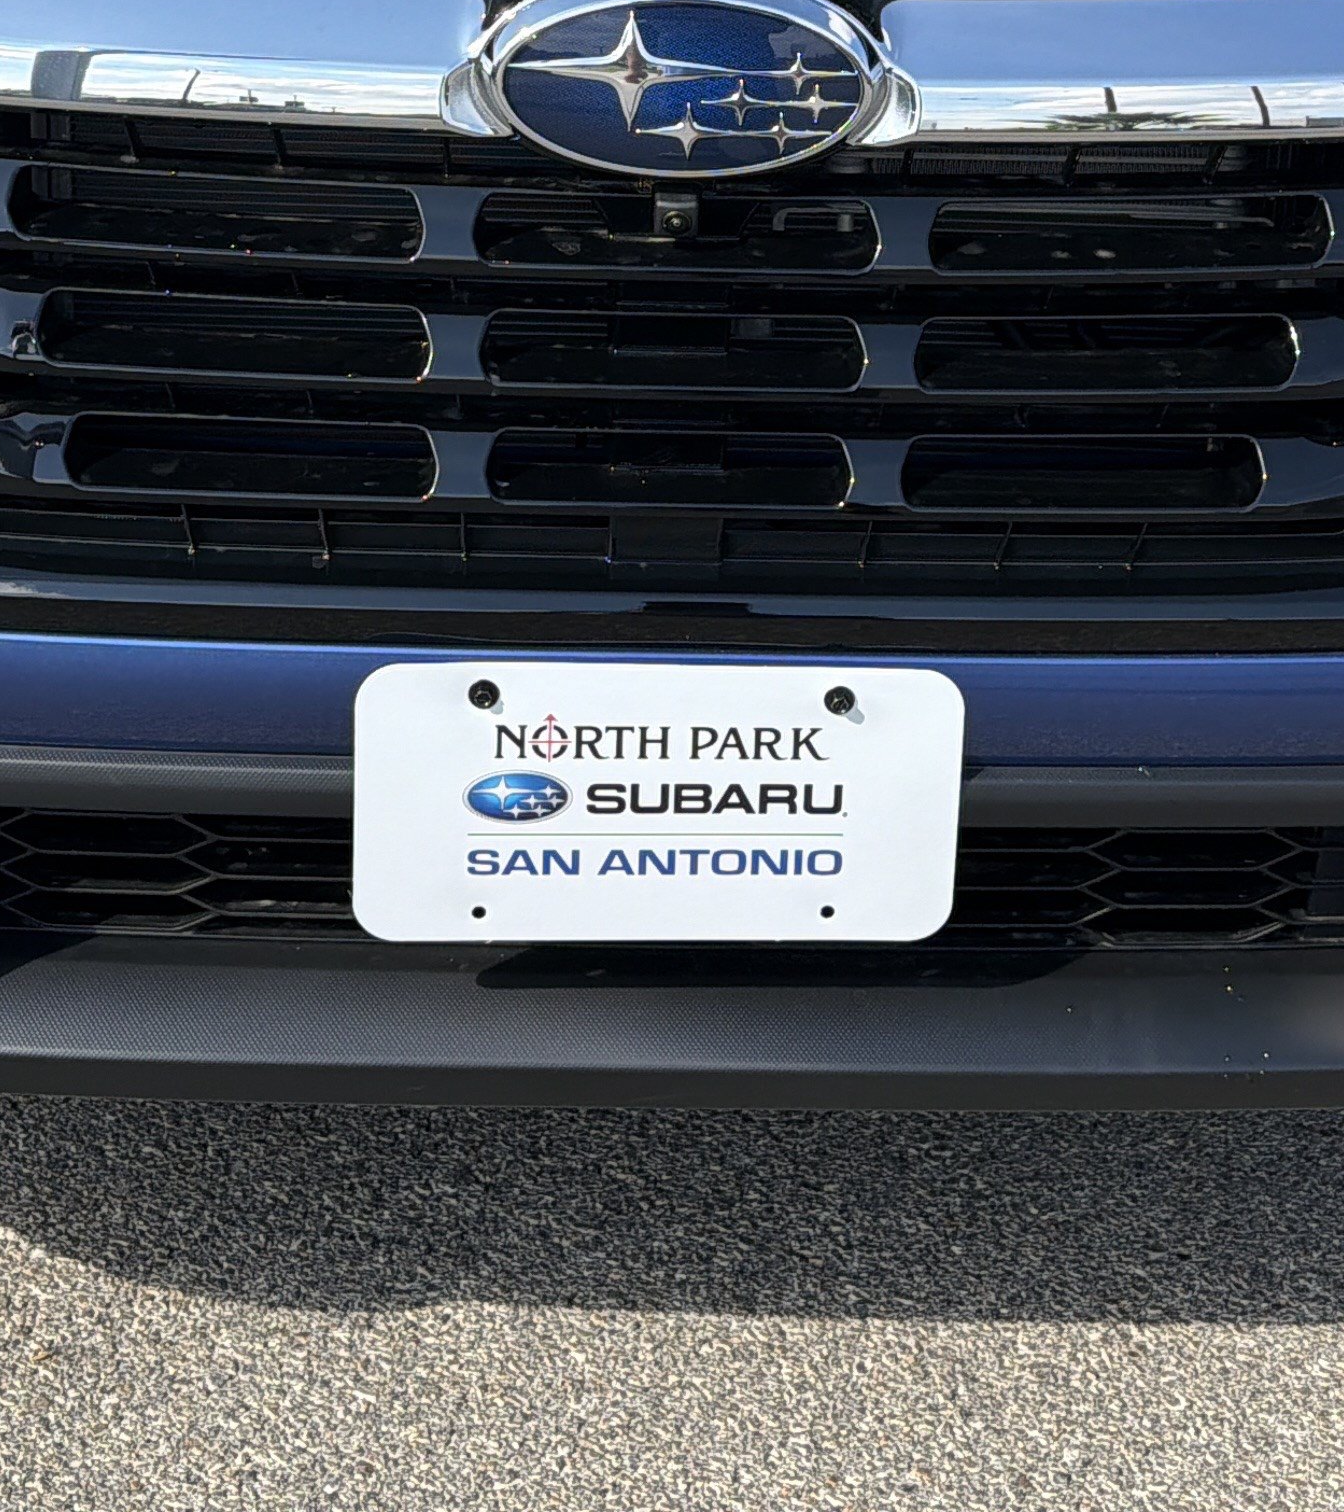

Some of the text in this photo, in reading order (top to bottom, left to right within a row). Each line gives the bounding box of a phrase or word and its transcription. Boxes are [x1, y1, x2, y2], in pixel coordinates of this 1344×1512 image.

[494, 722, 830, 761] NORTH PARK
[587, 784, 844, 816] SUBARU
[467, 849, 844, 876] SAN ANTONIO
